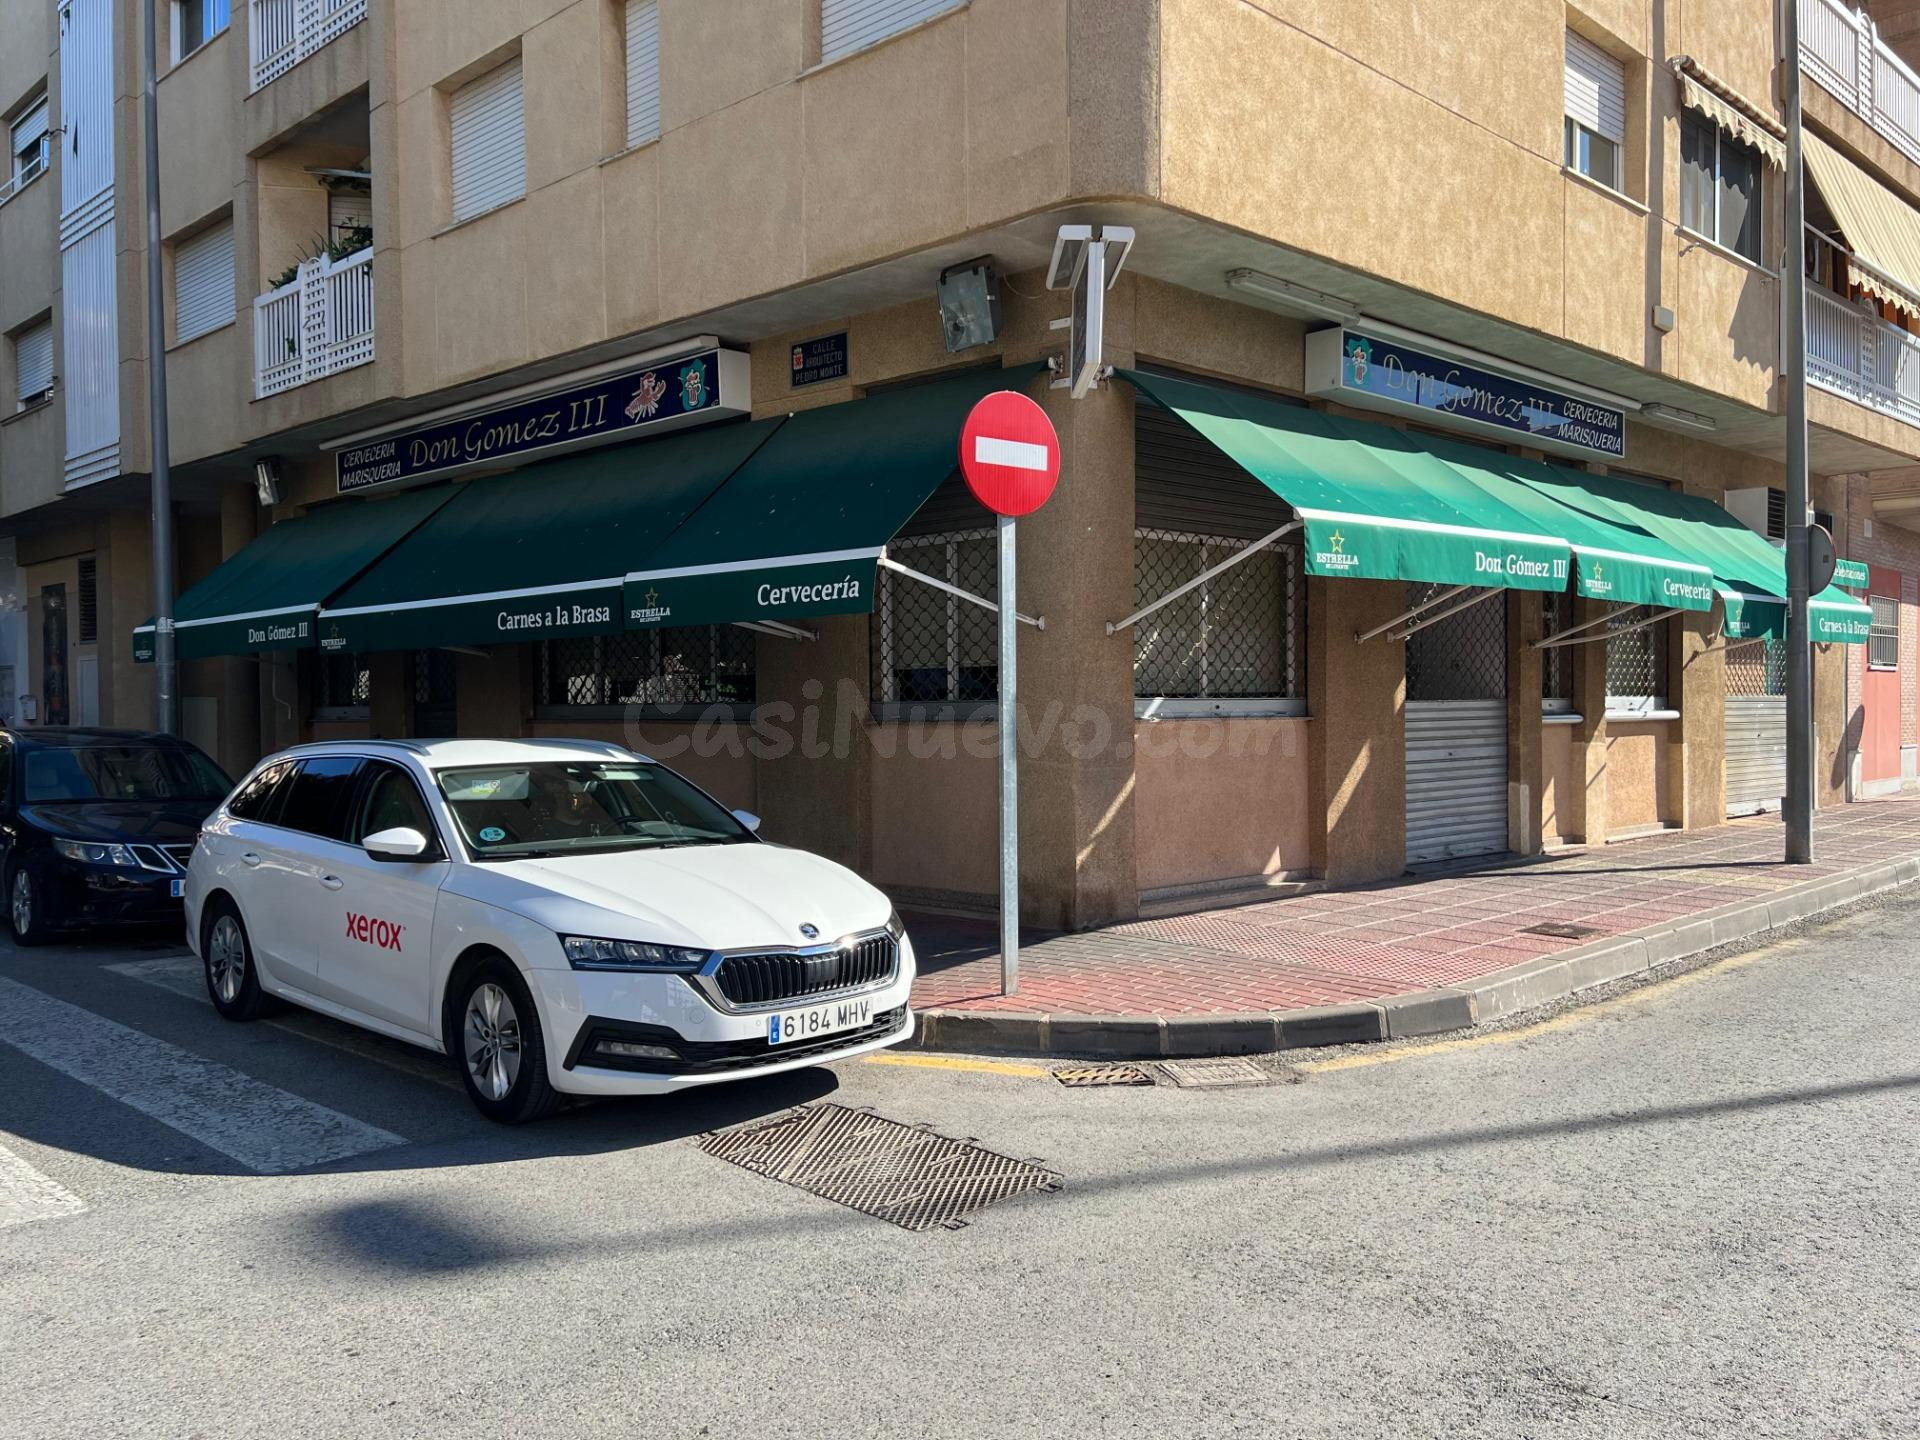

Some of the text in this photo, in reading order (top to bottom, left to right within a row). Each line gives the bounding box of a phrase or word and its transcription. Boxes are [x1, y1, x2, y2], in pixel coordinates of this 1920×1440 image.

[812, 340, 836, 353] CALLE
[795, 364, 843, 384] PEDRO MONTE
[1383, 354, 1555, 430] Don Gomez III
[1563, 400, 1618, 429] CERVECERIA
[409, 394, 609, 467] Don Gomez III
[1558, 423, 1621, 452] MARISQUERIA
[343, 441, 396, 468] CERVECERIA
[341, 460, 401, 486] MARISQUERIA
[1316, 552, 1359, 565] ESTRELLA
[1475, 552, 1567, 579] Don Gómez III
[1834, 565, 1866, 581] elebraciones
[757, 575, 859, 606] Cervecería
[1663, 577, 1711, 600] Cervecería
[497, 604, 610, 631] Carnes a la Brasa
[630, 607, 671, 619] ESTRELLA
[1819, 617, 1870, 635] Carnes a la Brasa
[248, 622, 308, 643] Don Gómez III
[346, 911, 402, 952] xerox
[784, 1000, 869, 1037] 6184 MHV
